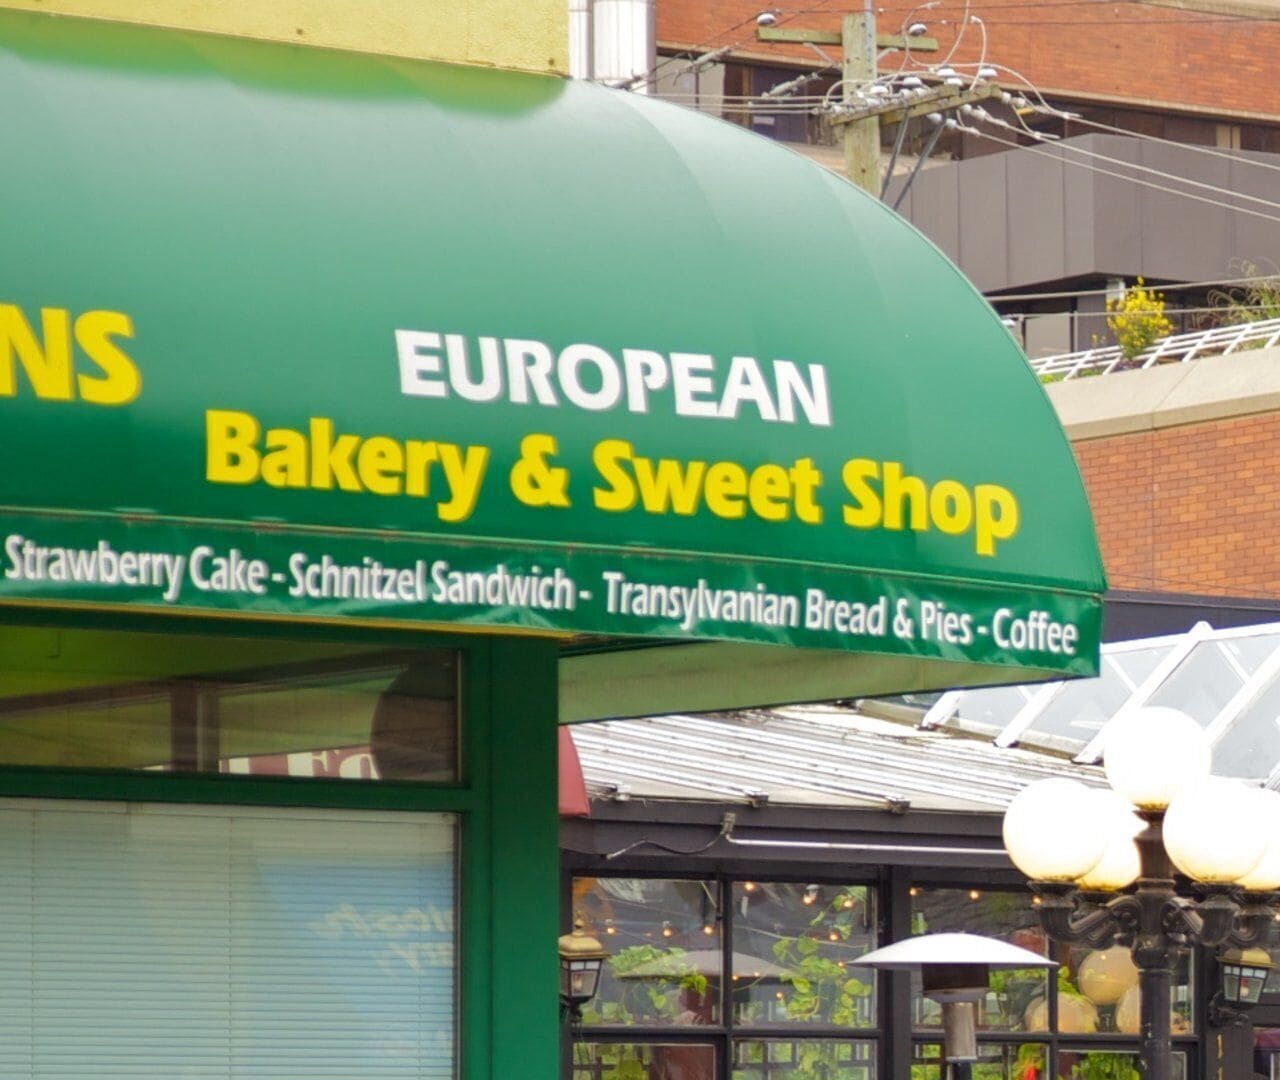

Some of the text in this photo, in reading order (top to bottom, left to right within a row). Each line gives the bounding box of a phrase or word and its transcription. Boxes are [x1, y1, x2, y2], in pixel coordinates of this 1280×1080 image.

[0, 304, 141, 404] NS
[395, 329, 831, 426] EUROPEAN
[206, 410, 1019, 556] Bakery & Sweet Shop
[5, 535, 184, 601] Strawberry
[190, 546, 268, 594] Cake
[289, 553, 426, 601] Schnitzel
[431, 560, 576, 611] Sandwich
[603, 571, 799, 631] Transylvanian
[805, 588, 885, 635] Bread
[892, 599, 914, 638] &
[920, 600, 972, 645] Pies
[992, 610, 1078, 655] Coffee
